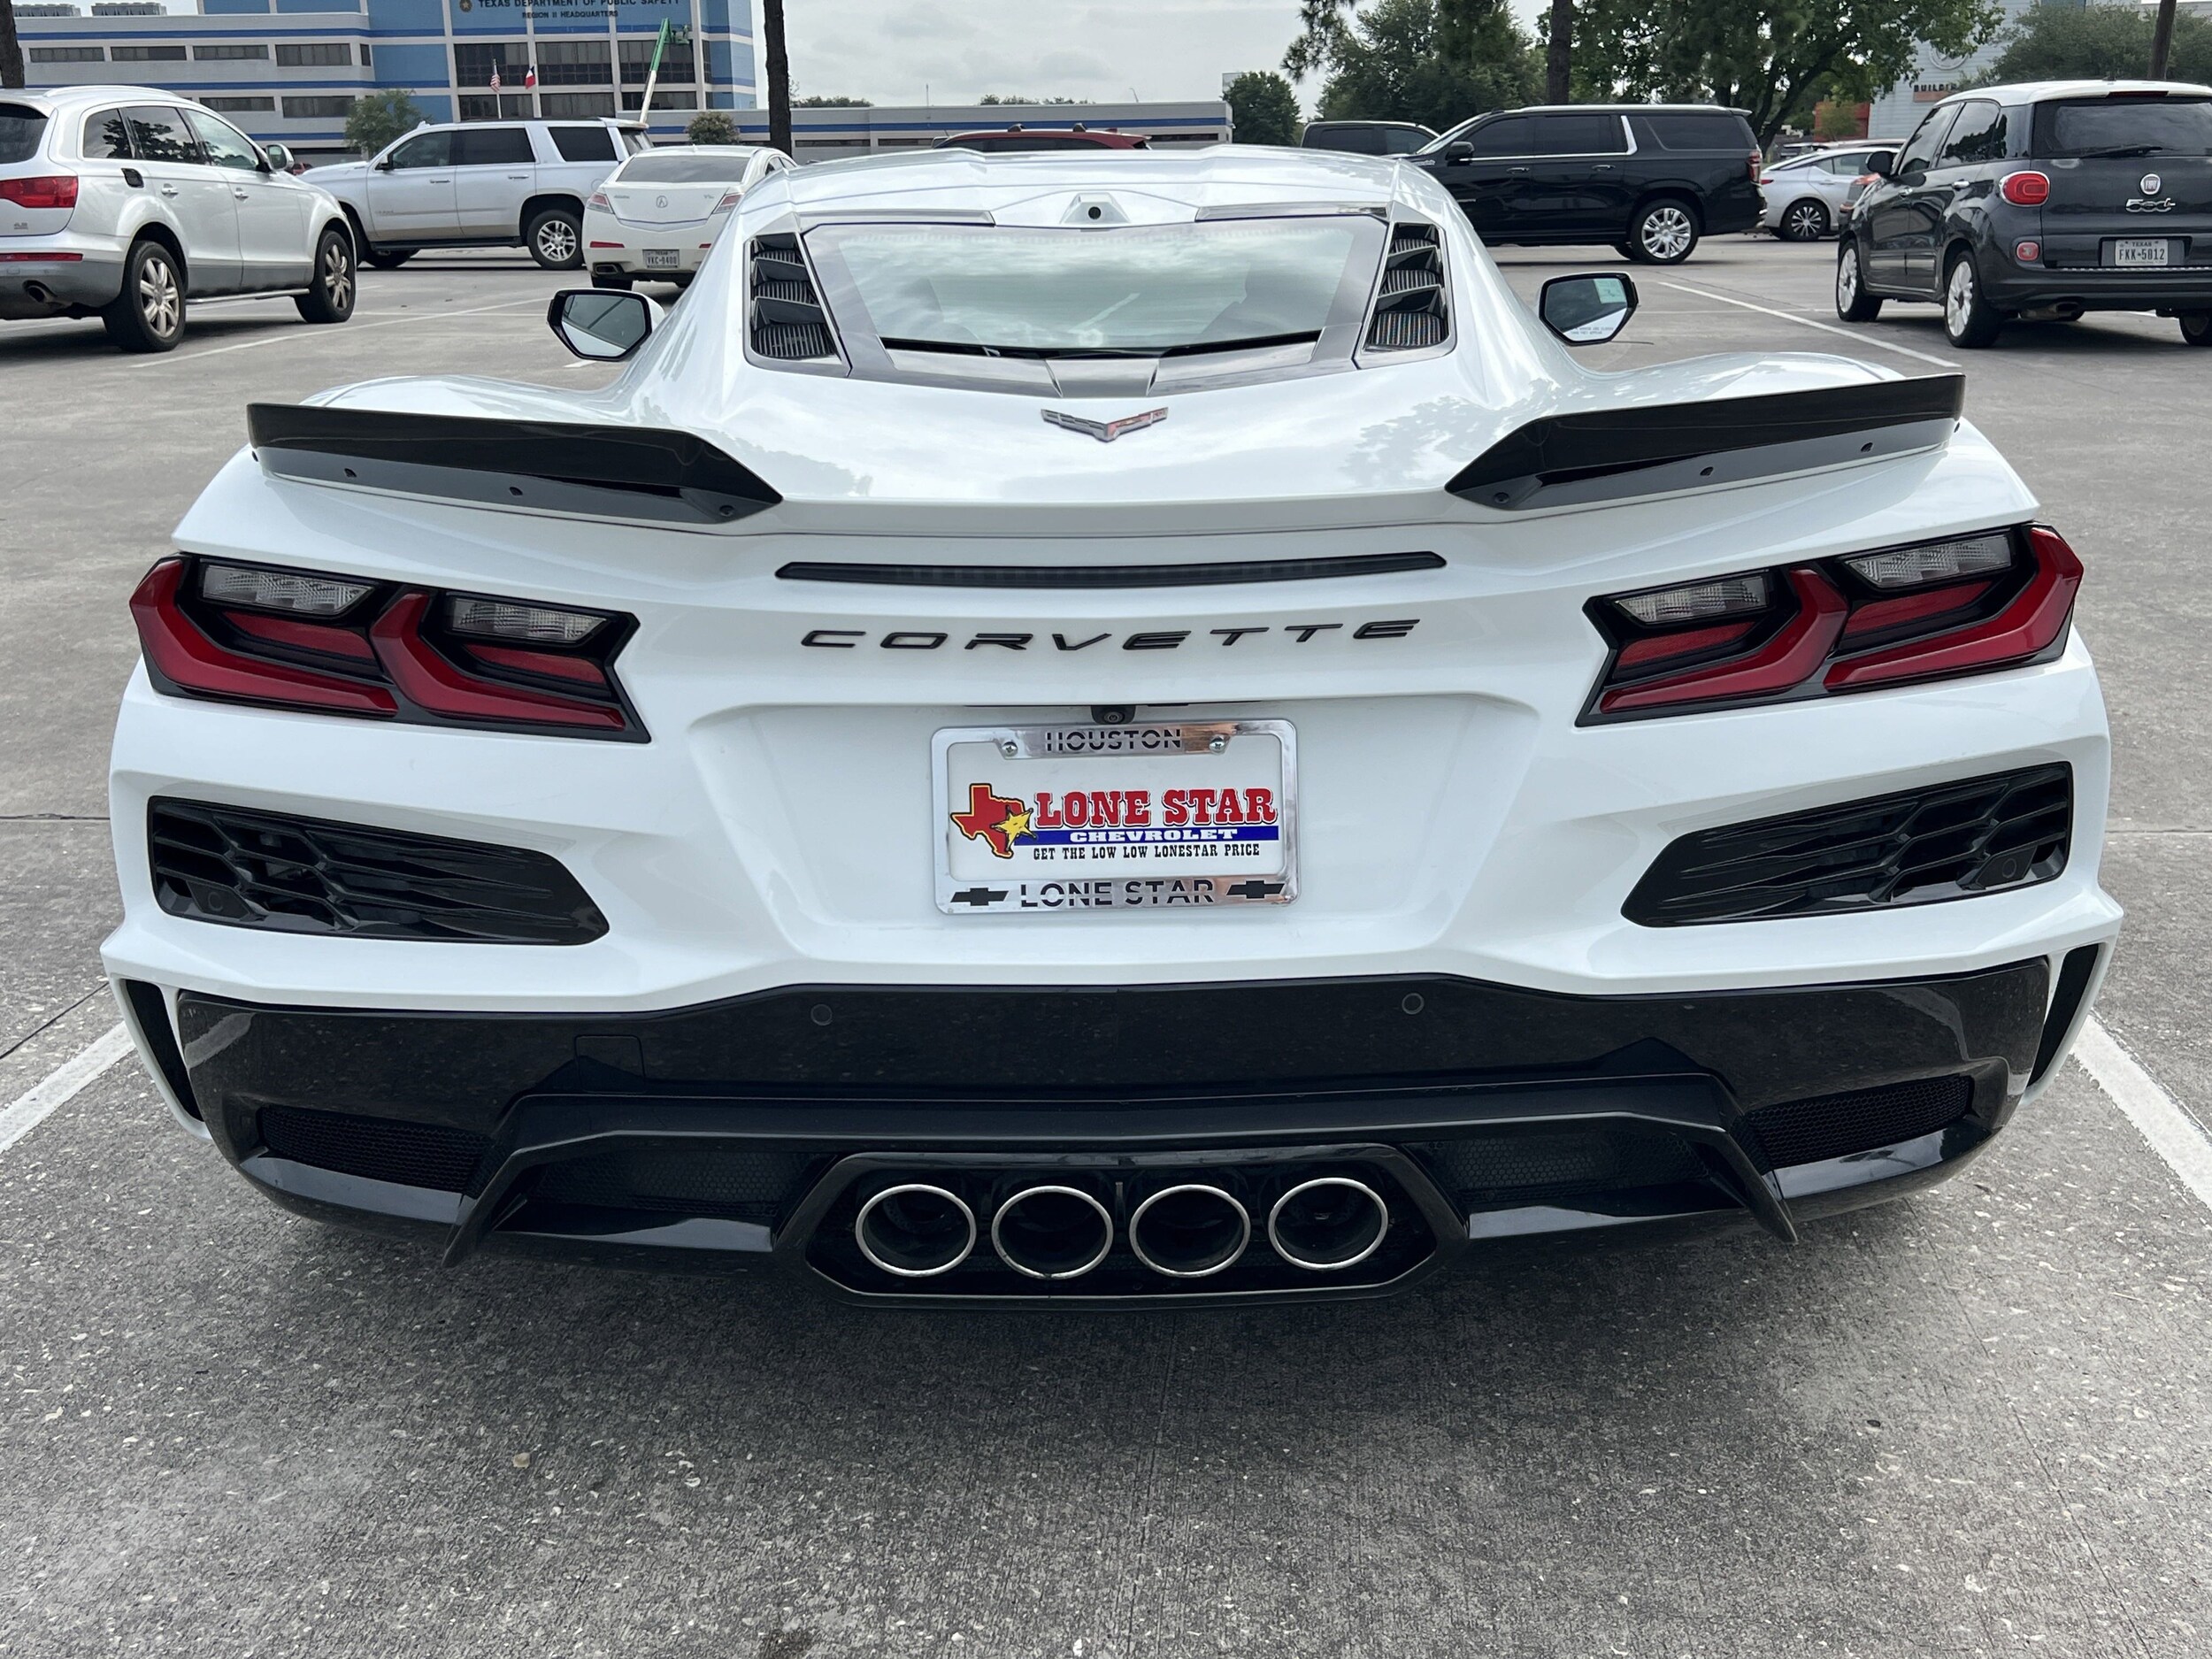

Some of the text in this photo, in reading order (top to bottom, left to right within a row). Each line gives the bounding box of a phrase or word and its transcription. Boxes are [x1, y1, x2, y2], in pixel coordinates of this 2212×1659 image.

[801, 619, 1420, 651] CORVETTE
[1047, 729, 1181, 751] HOUSTON
[1034, 787, 1279, 829] LONE STAR
[1070, 829, 1238, 843] CHEVROLET
[1033, 843, 1260, 860] GET THE LOW LOW LONESTAR PRICE
[1020, 879, 1214, 908] LONE STAR
